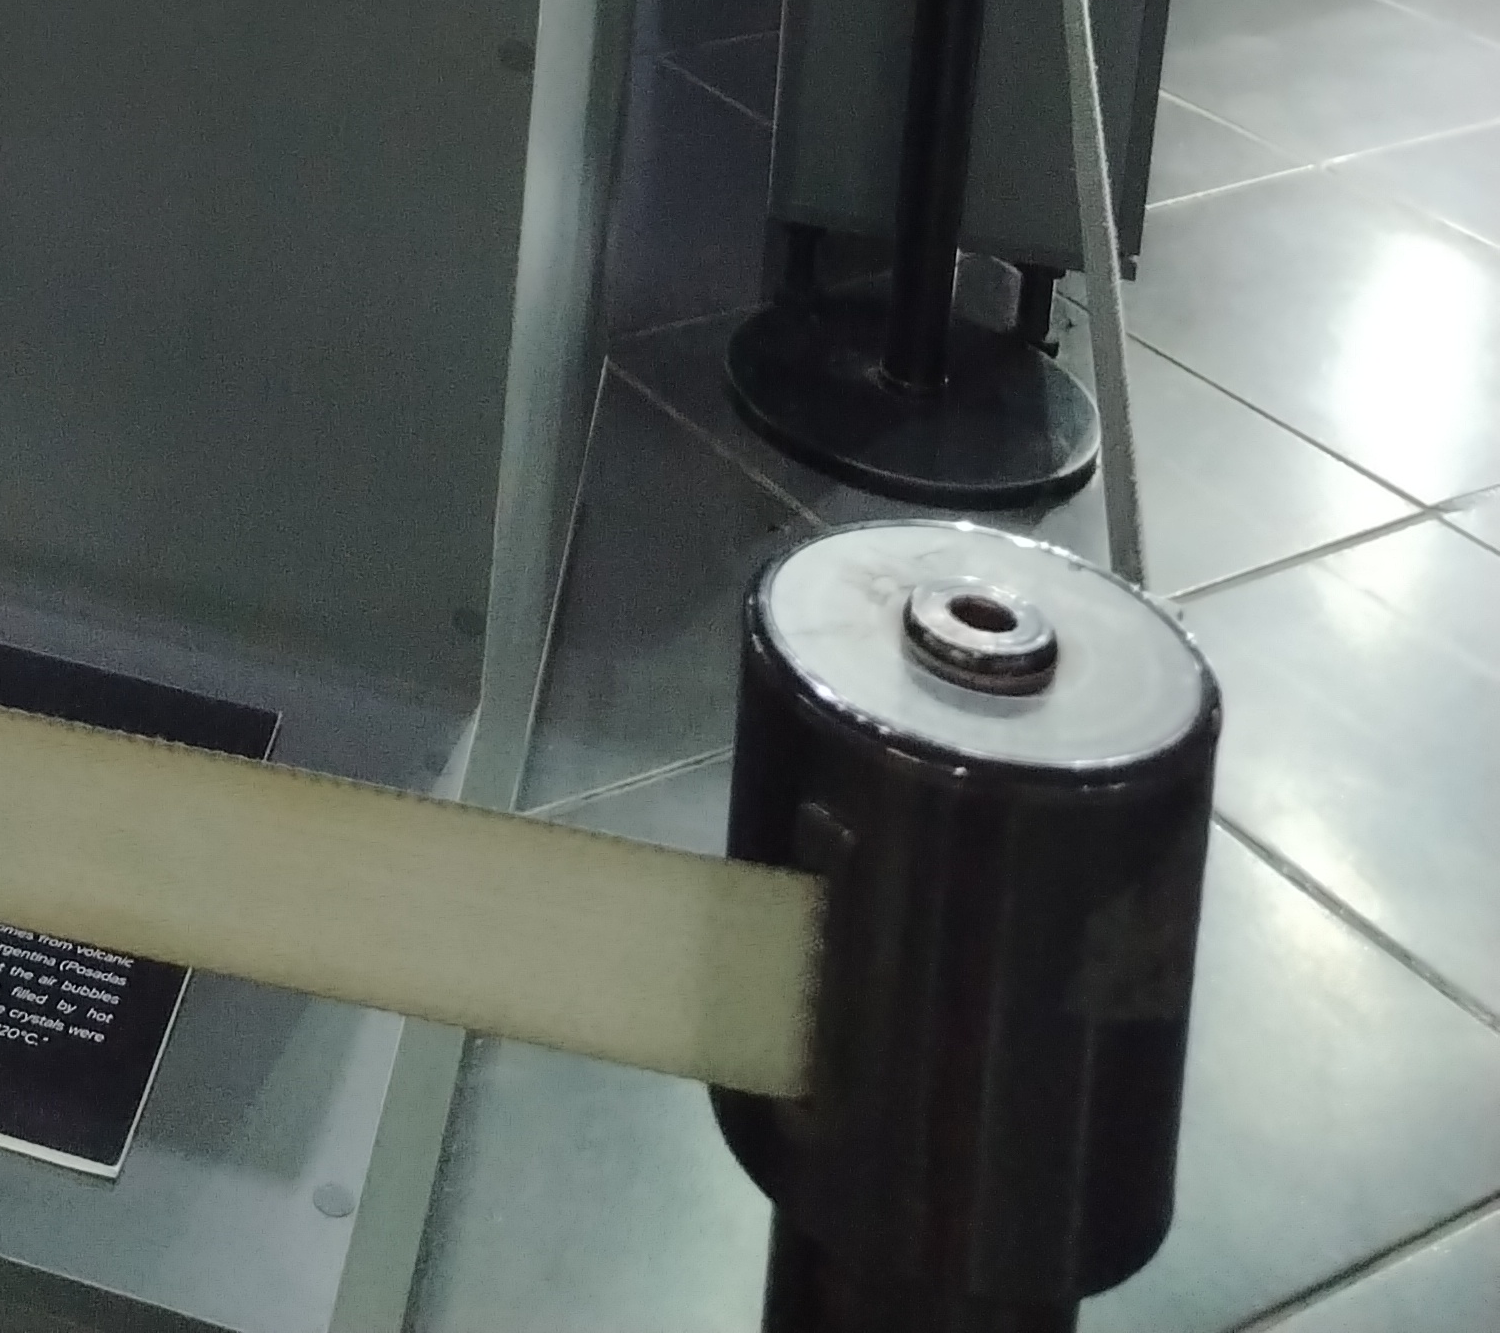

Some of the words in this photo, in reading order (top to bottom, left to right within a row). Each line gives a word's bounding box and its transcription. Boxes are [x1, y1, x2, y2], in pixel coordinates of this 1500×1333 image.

[59, 959, 128, 987] (Posadas
[76, 945, 134, 969] volcanic
[10, 965, 34, 981] the
[38, 975, 58, 987] air
[60, 980, 121, 1005] bubbles
[11, 987, 49, 1005] filled
[56, 999, 78, 1015] by
[86, 1007, 114, 1025] hot
[9, 1007, 65, 1033] crystals
[68, 1025, 106, 1043] were
